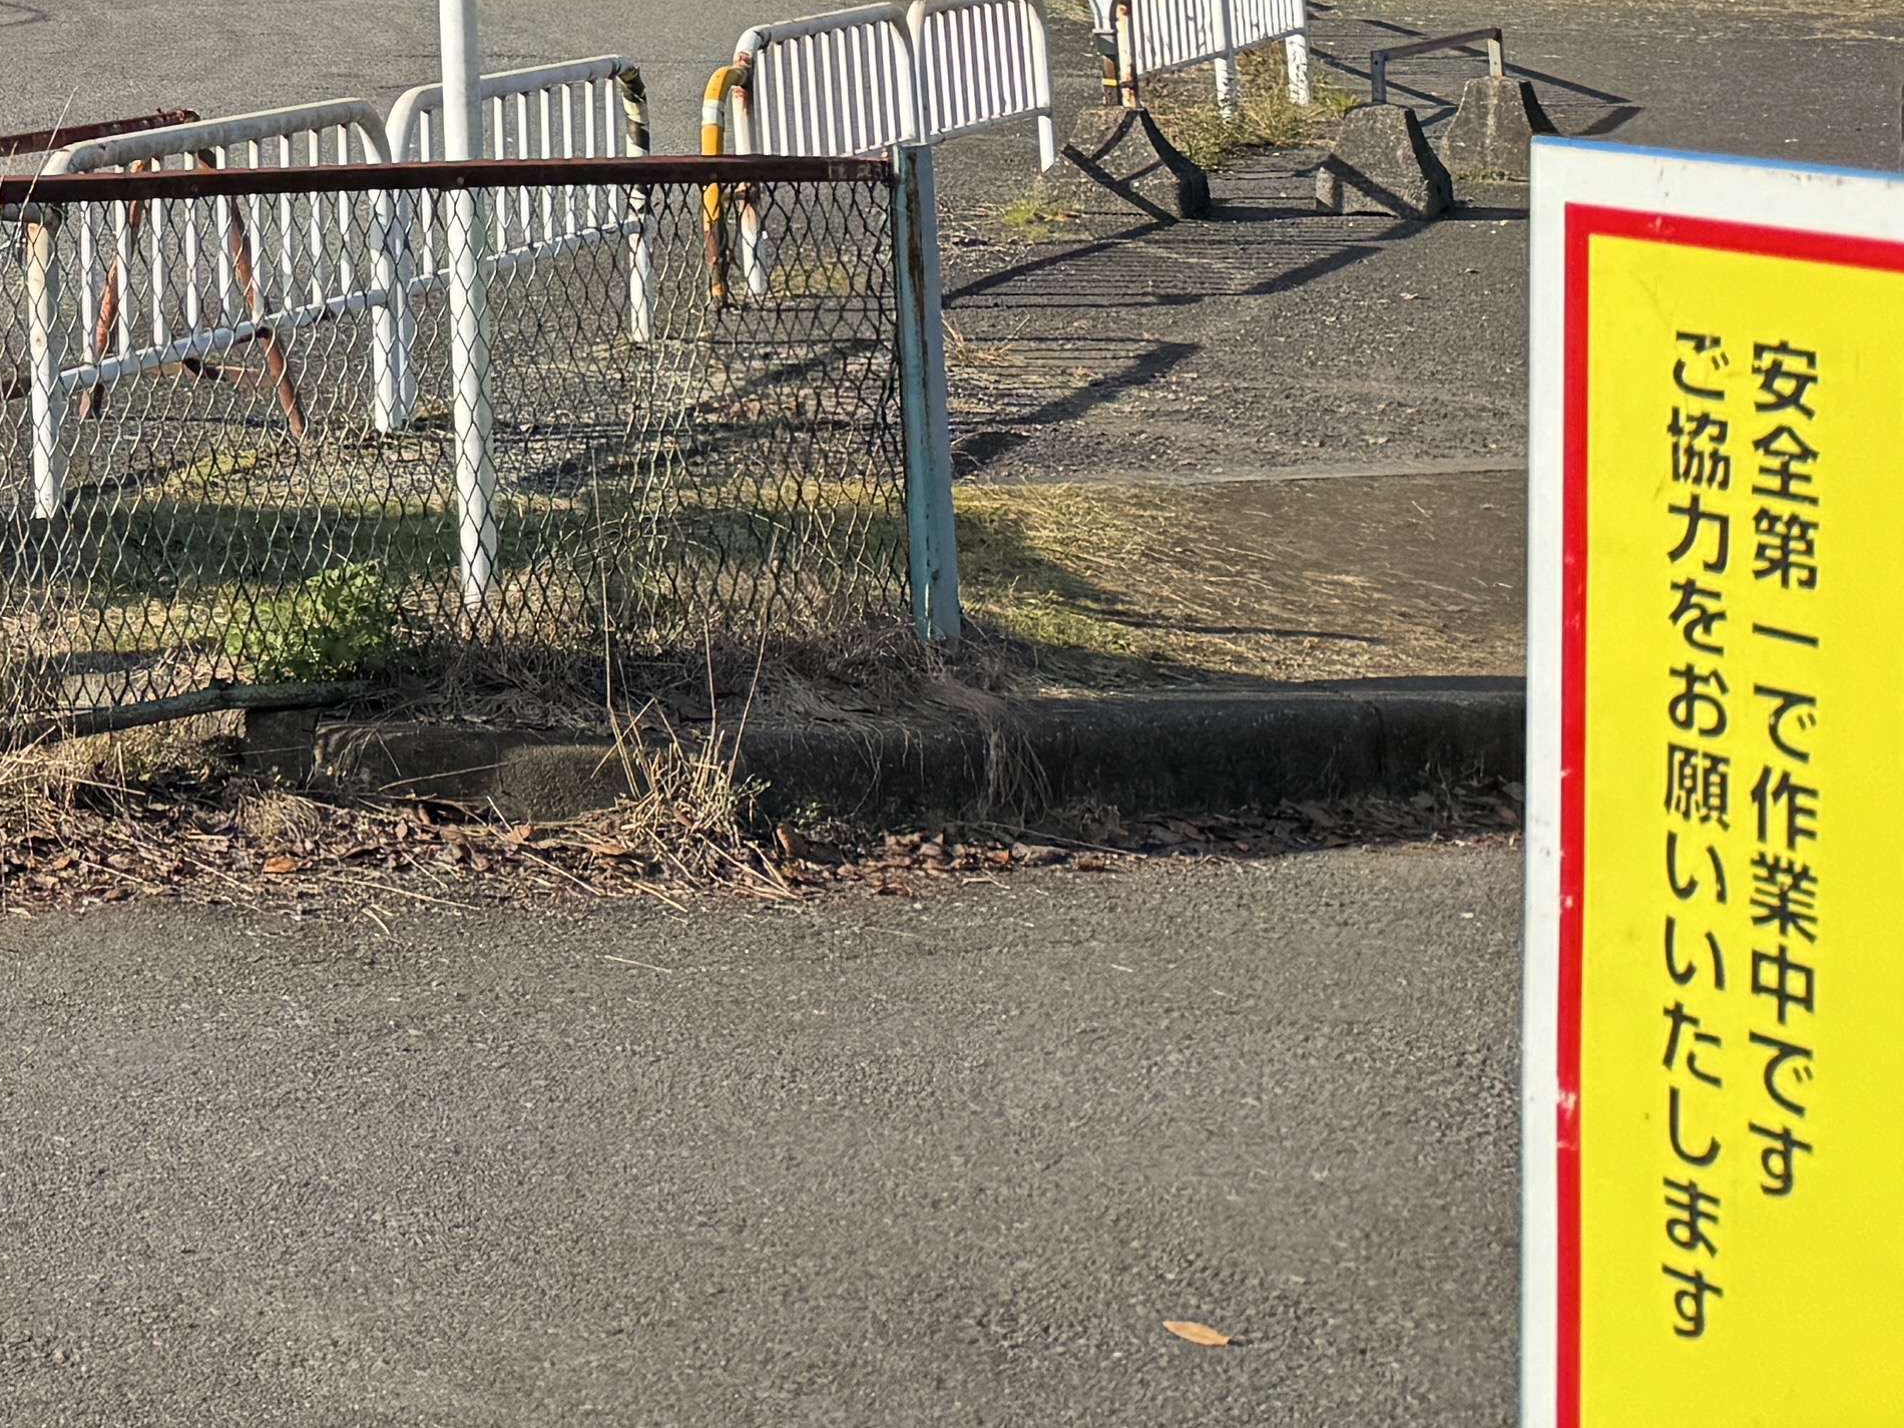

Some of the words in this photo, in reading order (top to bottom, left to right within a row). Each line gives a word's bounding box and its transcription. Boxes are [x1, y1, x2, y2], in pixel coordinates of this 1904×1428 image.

[1661, 329, 1730, 1341] ご協力をお願いいたします
[1748, 338, 1820, 1197] 安全第一で作業中です
